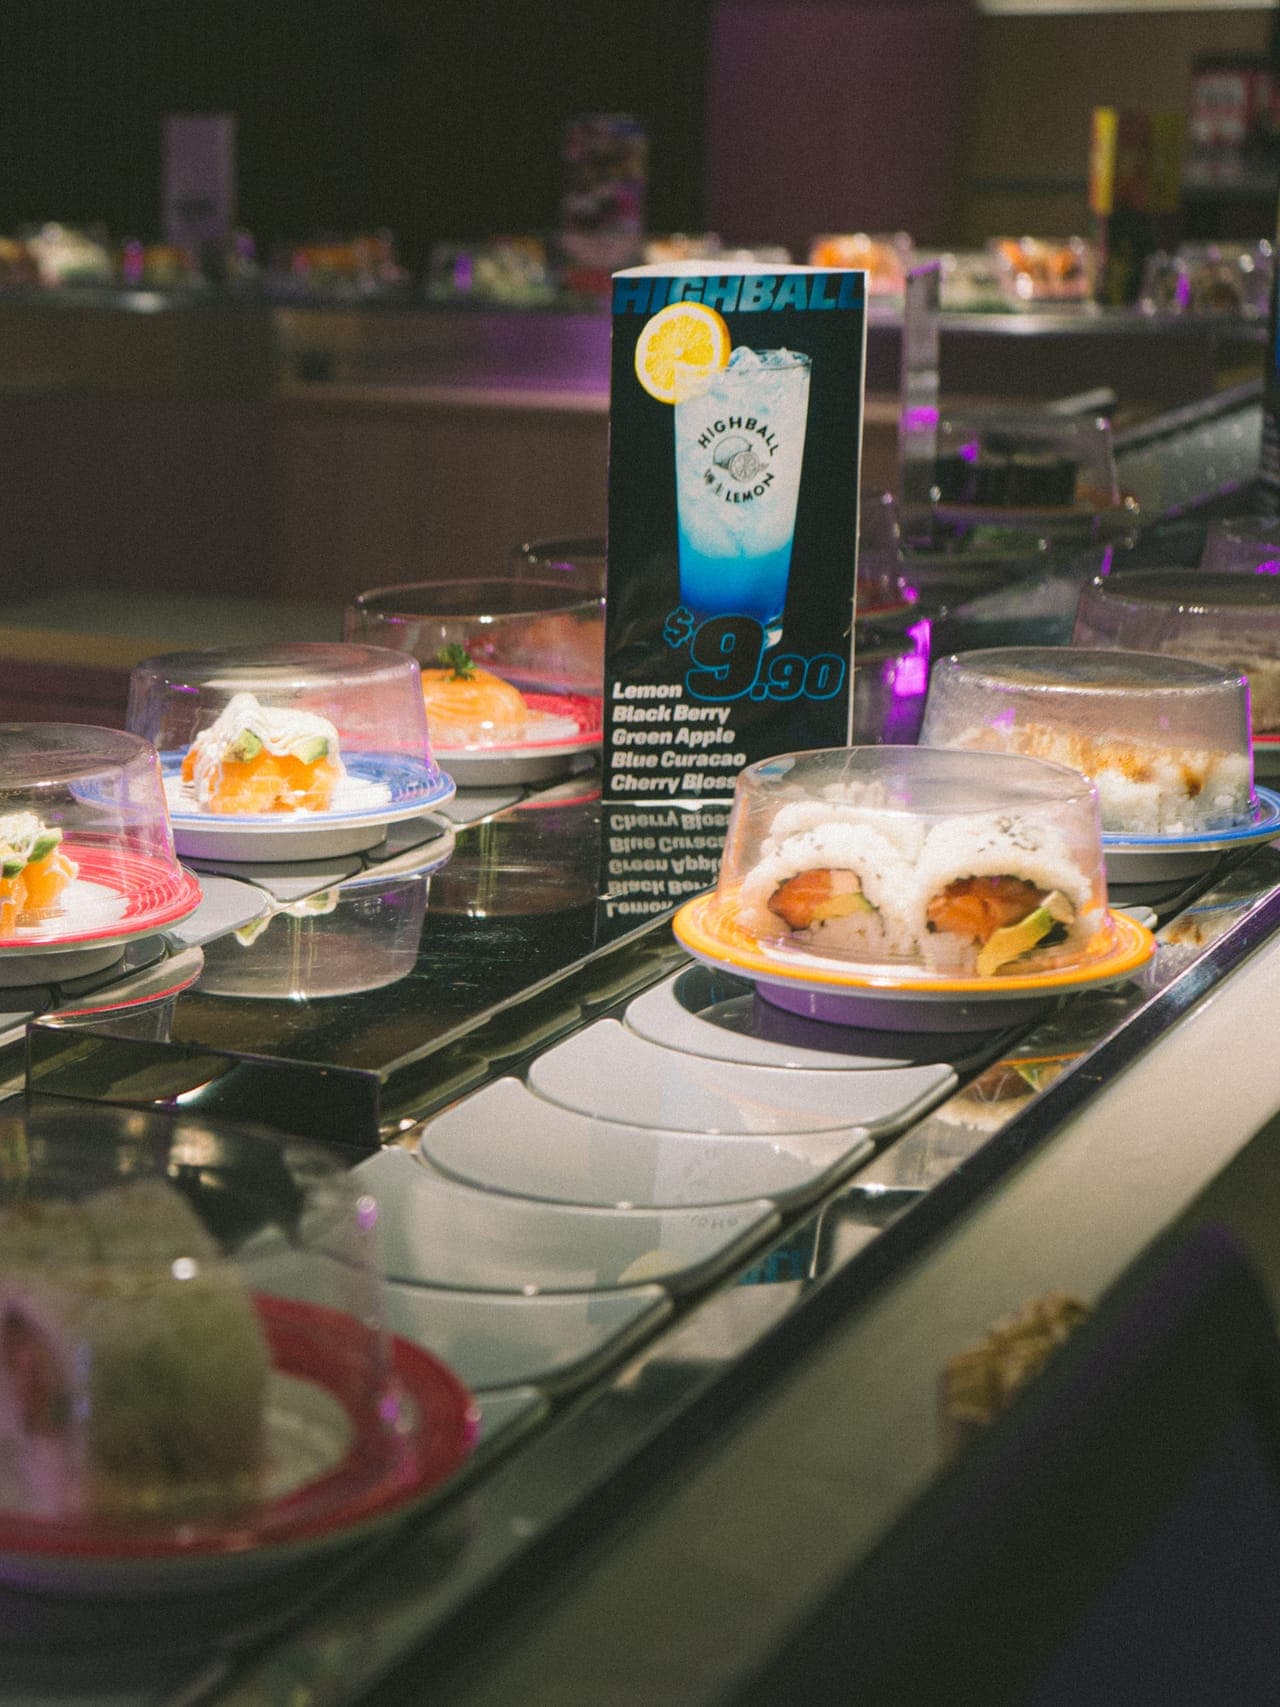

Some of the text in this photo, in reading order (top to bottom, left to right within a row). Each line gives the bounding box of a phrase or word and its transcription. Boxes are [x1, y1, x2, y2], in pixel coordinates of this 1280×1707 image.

[612, 272, 865, 314] HIGHBALL
[698, 416, 779, 456] HIGHBALL
[725, 472, 775, 503] LEMON
[663, 606, 846, 701] $9.90
[612, 682, 683, 699] Lemon
[612, 704, 731, 725] Black Berry
[612, 726, 736, 748] Green Apple
[611, 750, 747, 768] Blue Curacao
[610, 772, 737, 795] Cherry Bloss
